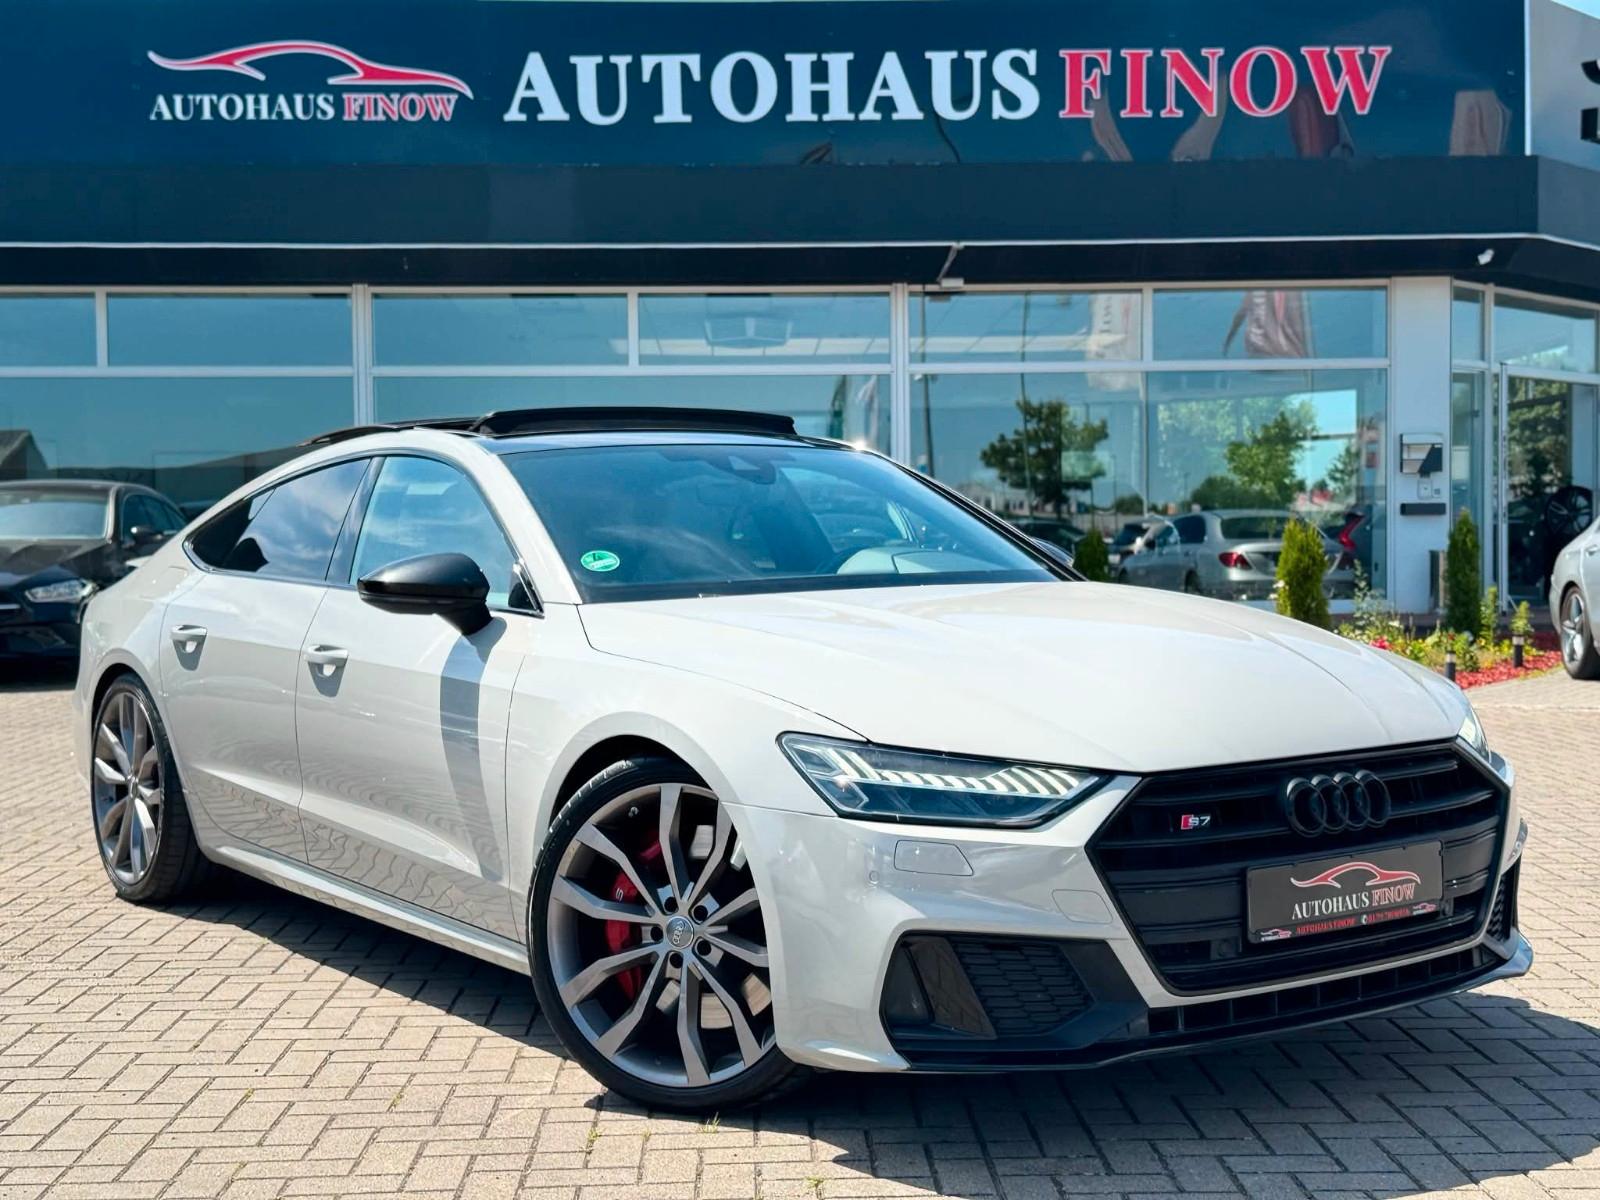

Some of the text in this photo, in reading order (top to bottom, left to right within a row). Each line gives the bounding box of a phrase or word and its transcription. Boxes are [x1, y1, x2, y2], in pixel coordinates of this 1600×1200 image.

[503, 46, 1391, 125] AUTOHAUS FINOW
[149, 92, 459, 122] AUTOHAUS FINOW
[1188, 815, 1211, 826] S7
[1292, 891, 1370, 920] AUTOHAUS
[1371, 882, 1416, 907] FINOW
